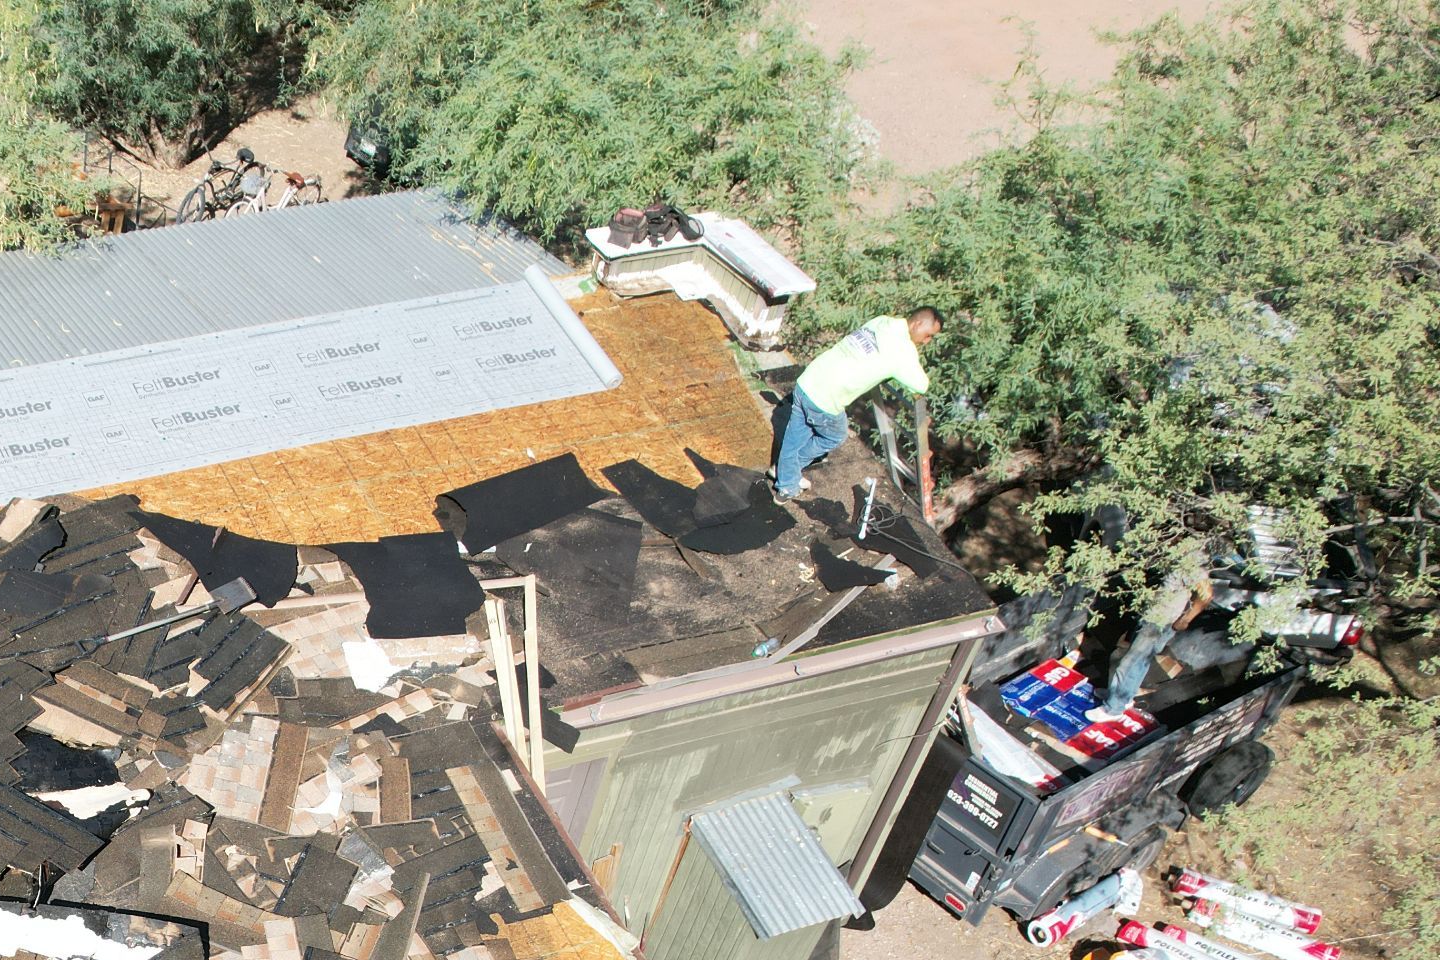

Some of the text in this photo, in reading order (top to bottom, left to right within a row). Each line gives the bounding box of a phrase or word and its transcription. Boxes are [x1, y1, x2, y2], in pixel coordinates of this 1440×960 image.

[453, 315, 533, 336] FeltBuster
[296, 341, 381, 363] FeltBuster
[475, 347, 557, 369] FeltBuster
[132, 370, 220, 394] FeltBuster
[318, 374, 403, 397] FeltBuster
[87, 394, 105, 402] GAF
[151, 404, 240, 429] FeltBuster
[106, 430, 124, 438] GAF
[1044, 667, 1070, 685] GAF
[1085, 729, 1120, 750] GAF
[1154, 939, 1195, 960] POLYFLEX
